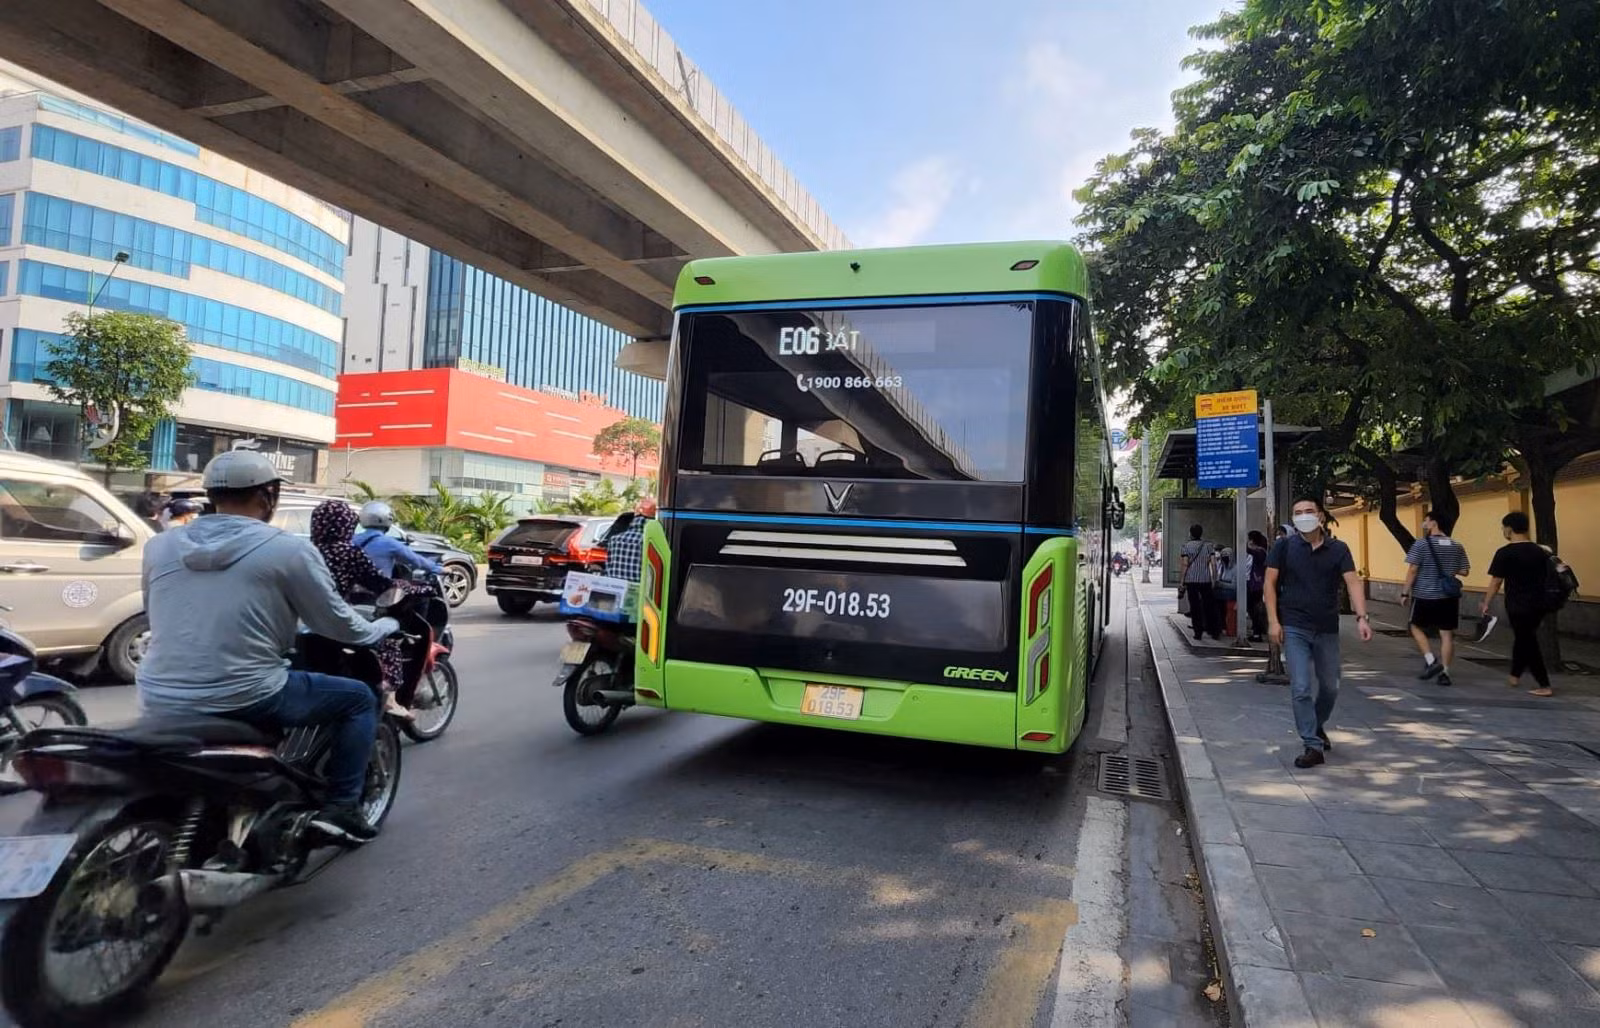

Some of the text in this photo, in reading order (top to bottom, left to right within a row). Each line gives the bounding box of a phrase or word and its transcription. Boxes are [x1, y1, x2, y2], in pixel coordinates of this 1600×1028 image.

[779, 326, 820, 355] E06
[807, 376, 902, 389] 1900 866 663
[782, 588, 891, 618] 29F-018.53
[944, 666, 1009, 683] GREEN
[821, 686, 847, 700] 29F
[807, 699, 854, 716] 018.53
